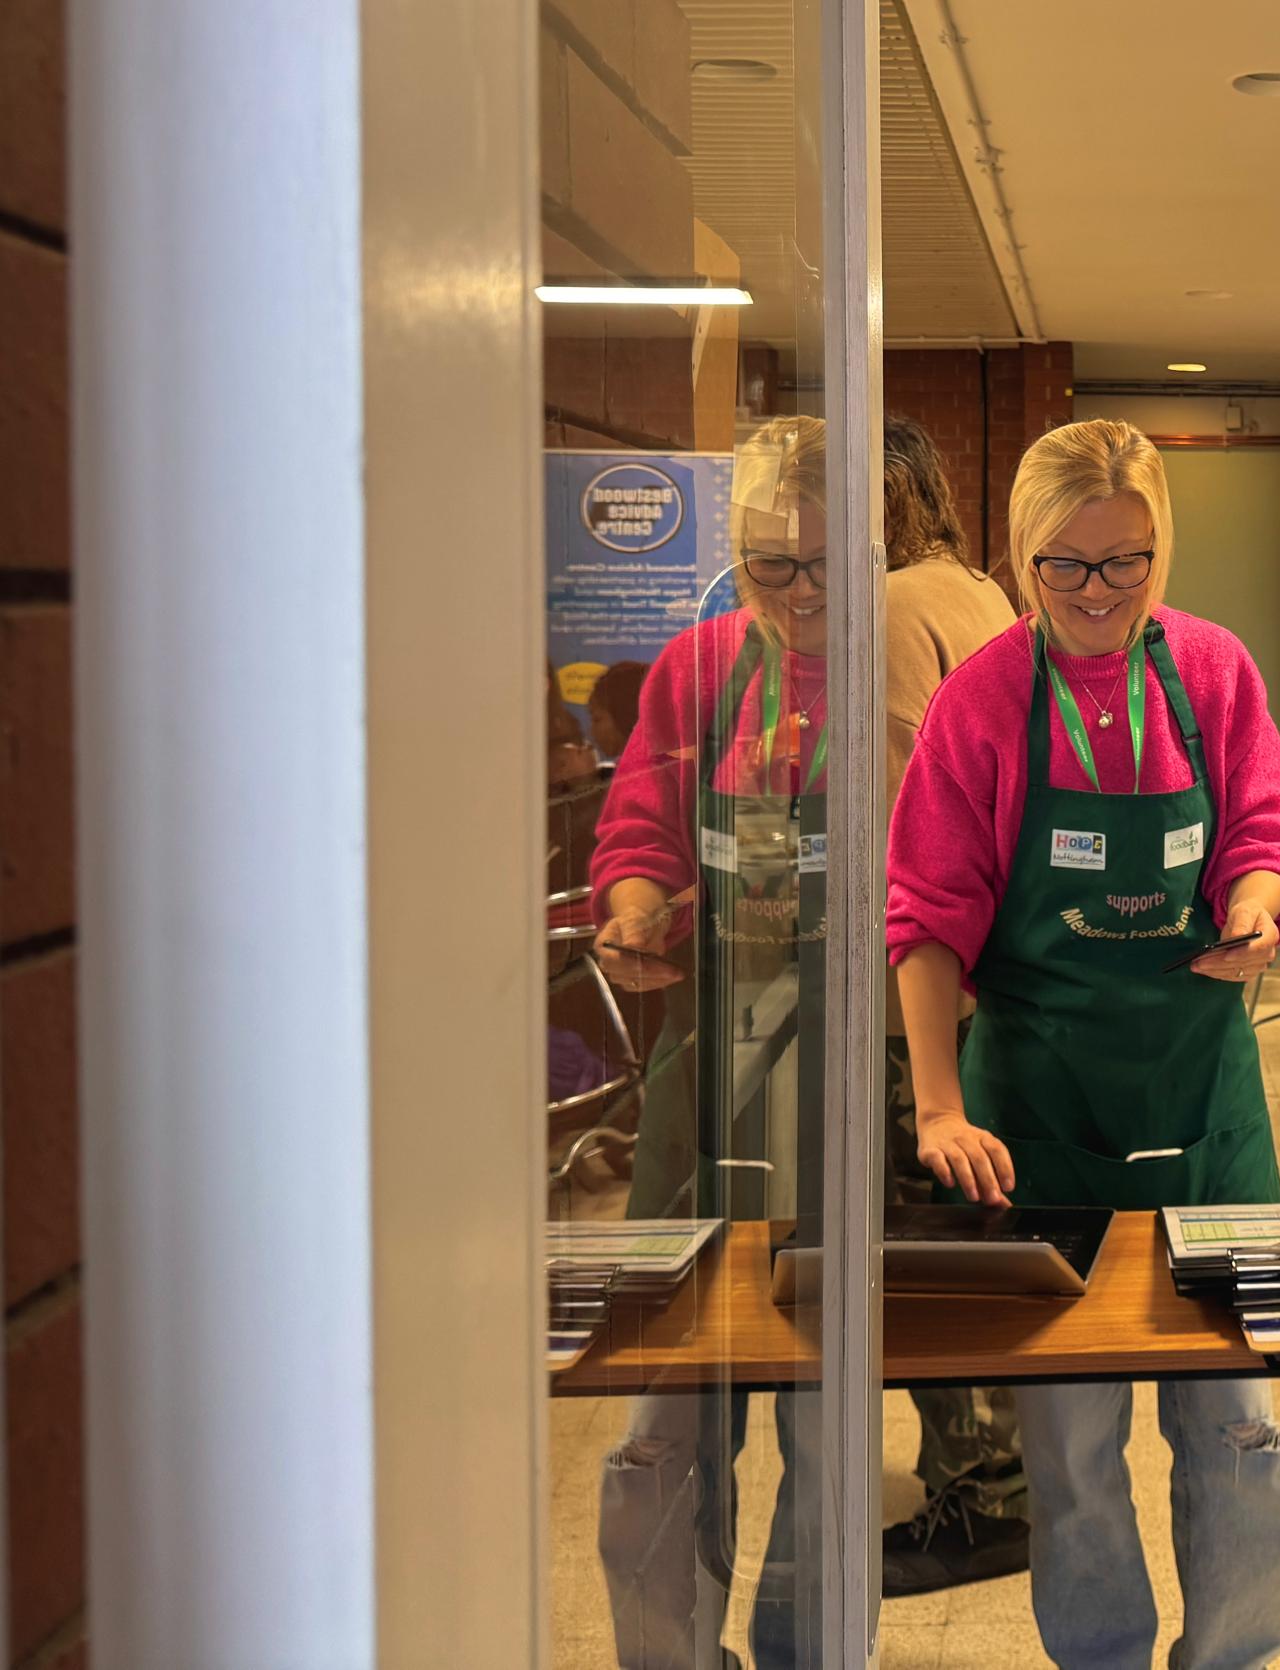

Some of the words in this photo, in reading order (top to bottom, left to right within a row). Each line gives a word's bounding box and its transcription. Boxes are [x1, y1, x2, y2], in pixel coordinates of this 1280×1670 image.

[1133, 662, 1141, 696] Volunteer
[1073, 729, 1089, 762] Volunteer
[1053, 852, 1104, 864] Nottingham
[1105, 891, 1167, 918] supports
[1060, 908, 1127, 939] Meadows
[1129, 905, 1195, 939] Foodbank
